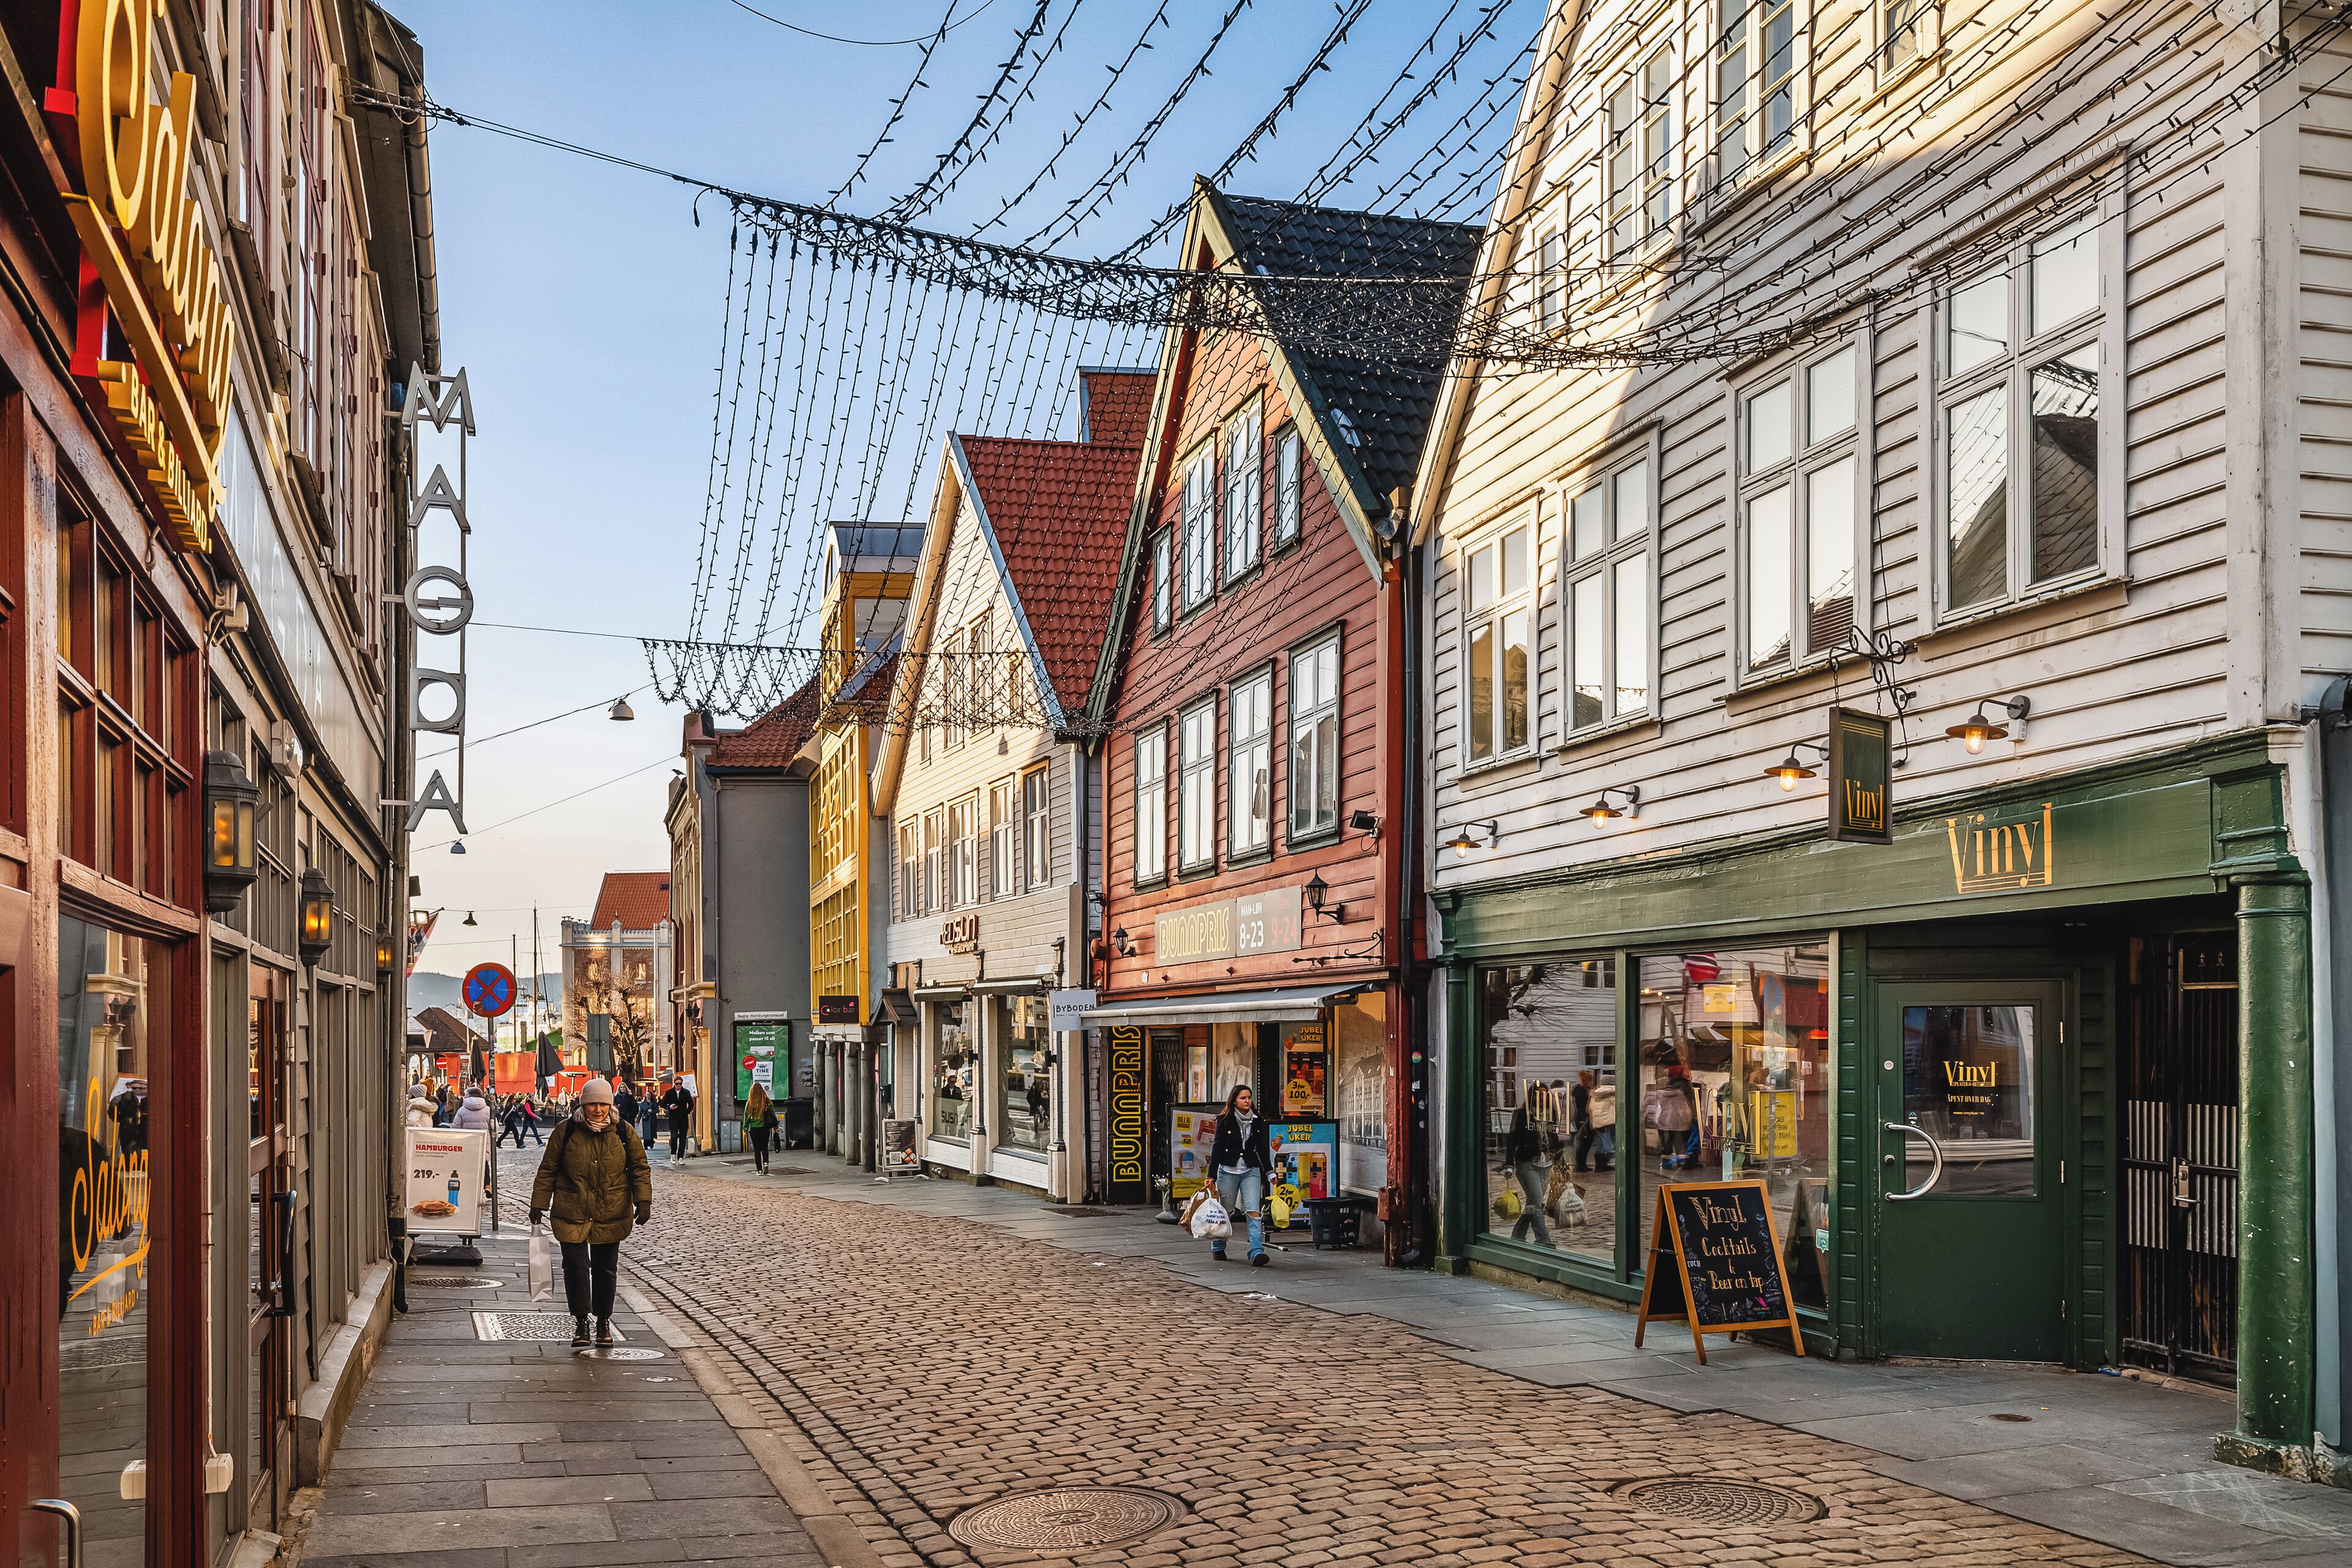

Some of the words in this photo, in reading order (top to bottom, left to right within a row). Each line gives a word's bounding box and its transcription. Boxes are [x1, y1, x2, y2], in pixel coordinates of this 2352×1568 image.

[130, 363, 156, 452] BAR
[157, 421, 166, 471] &
[167, 440, 207, 551] BILLIARD
[402, 361, 475, 834] MAGDA
[1845, 778, 1883, 829] Vinyl
[1945, 802, 2052, 894] Vinyl
[1240, 902, 1262, 917] MAN-LØR
[1239, 920, 1264, 949] 8-23
[1271, 916, 1298, 946] 9-24
[1056, 1004, 1095, 1012] BYBODEN
[1943, 1060, 1996, 1087] Vinyl
[1112, 1025, 1141, 1182] BUNNPRIS
[1289, 1090, 1310, 1100] 100,-
[1522, 1079, 1570, 1135] Vinyl
[1287, 1124, 1313, 1133] JUBEL
[1692, 1087, 1760, 1155] Vinyl
[1289, 1134, 1311, 1142] UKER
[72, 1076, 151, 1279] Salong
[413, 1169, 440, 1179] 219,-
[1279, 1186, 1285, 1195] 2
[1702, 1237, 1757, 1256] Cocktails
[1728, 1258, 1736, 1275] &
[1708, 1270, 1733, 1290] Beer
[1735, 1277, 1747, 1288] on
[1748, 1270, 1764, 1294] tap
[92, 1310, 105, 1336] BAR
[111, 1288, 135, 1323] BILLIARD
